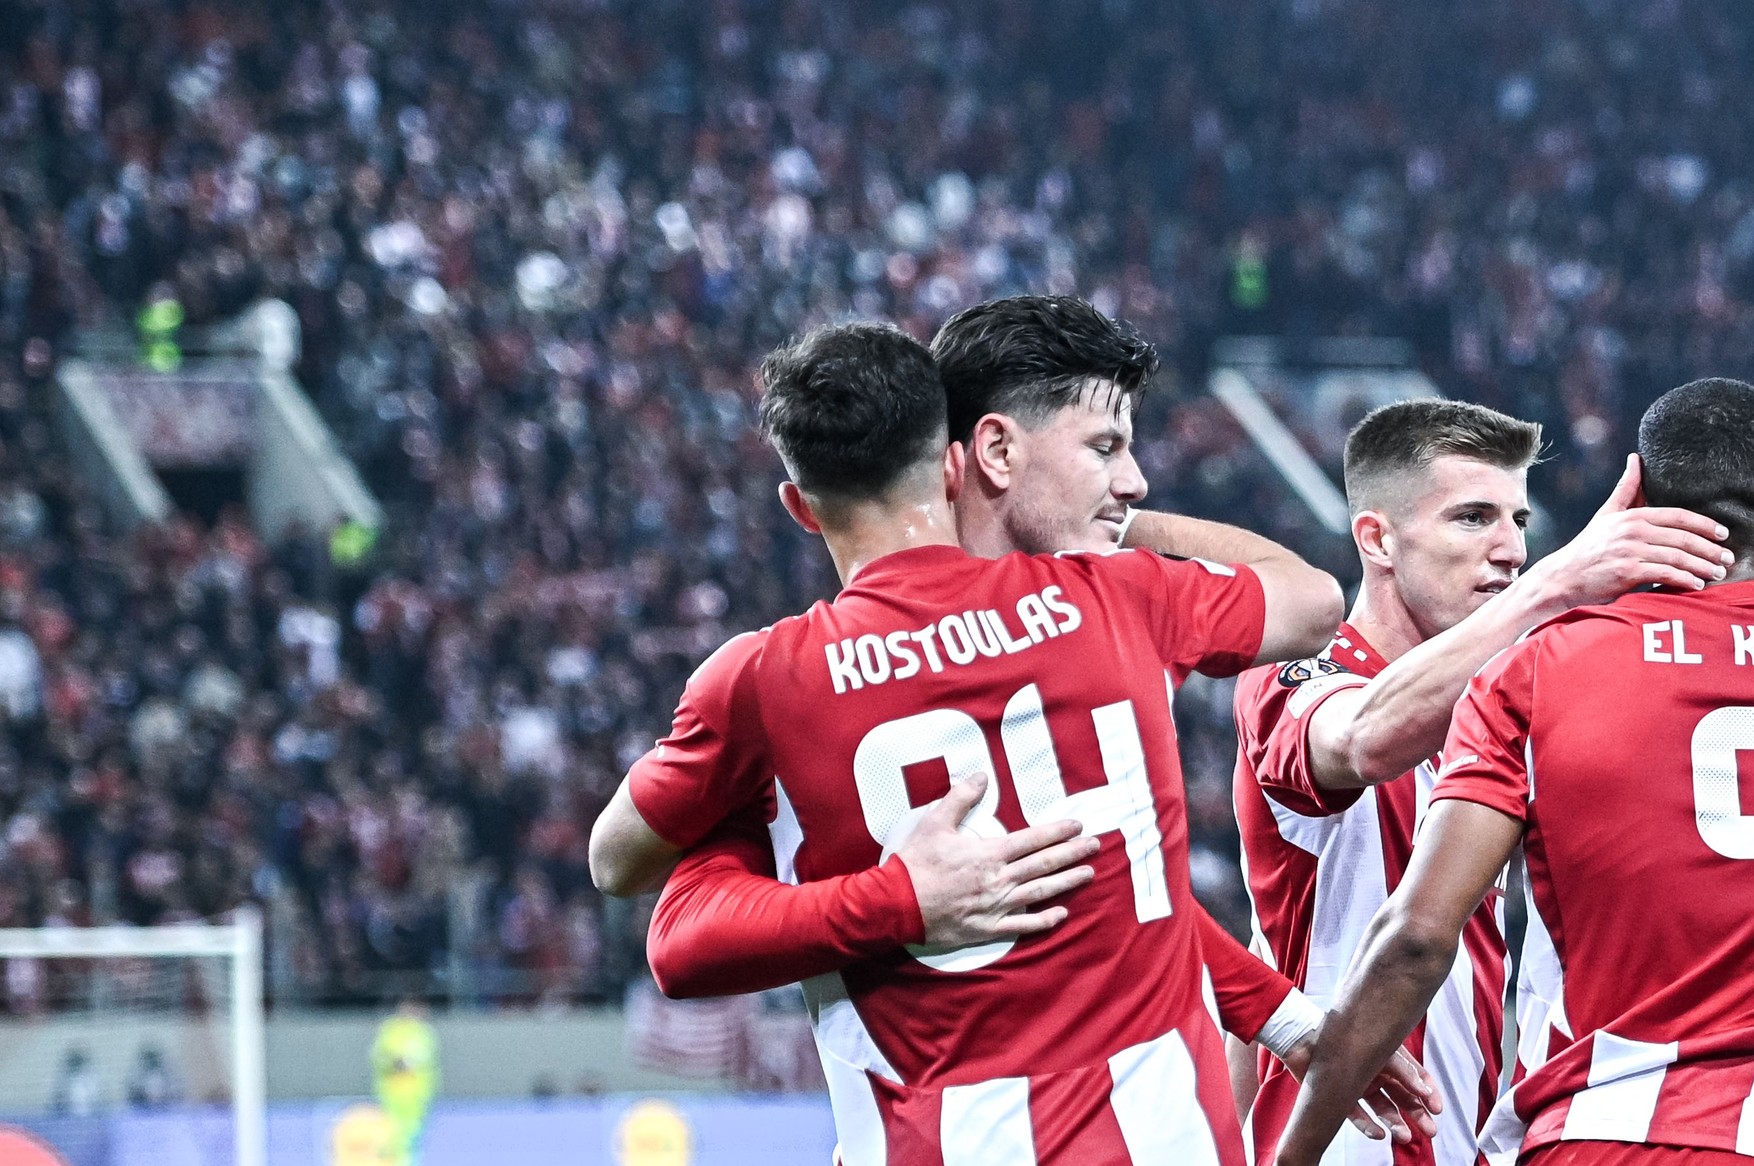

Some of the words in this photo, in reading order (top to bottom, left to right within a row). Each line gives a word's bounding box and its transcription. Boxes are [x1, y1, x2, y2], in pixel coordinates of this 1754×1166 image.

[824, 584, 1083, 695] KOSTOULAS
[1642, 619, 1703, 665] EL
[852, 683, 1174, 972] 84
